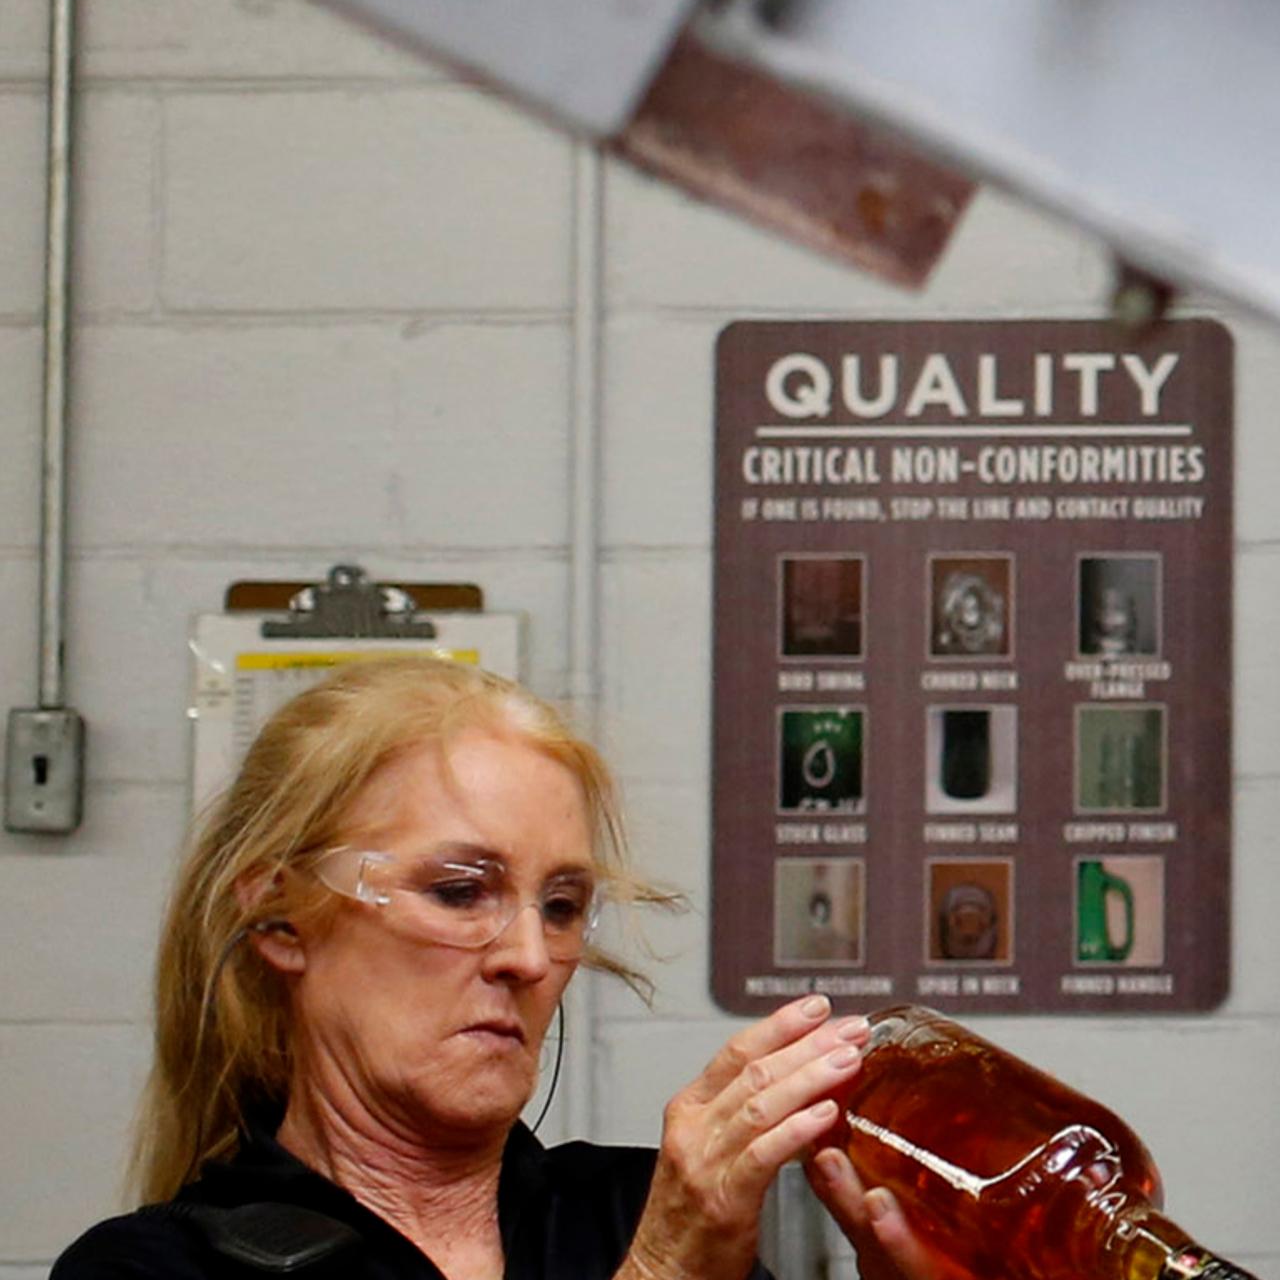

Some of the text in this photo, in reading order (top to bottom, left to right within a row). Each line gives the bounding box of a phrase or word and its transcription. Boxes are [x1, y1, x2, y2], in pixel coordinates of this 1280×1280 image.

[766, 353, 1179, 418] QUALITY
[743, 444, 1204, 484] CRITICAL NON-CONFORMITIES
[741, 497, 1205, 521] IF ONE IS FOUND, STOP THE LINE AND CONTACT QUALITY
[1091, 680, 1145, 699] FLANGE
[822, 822, 867, 843] GLASS
